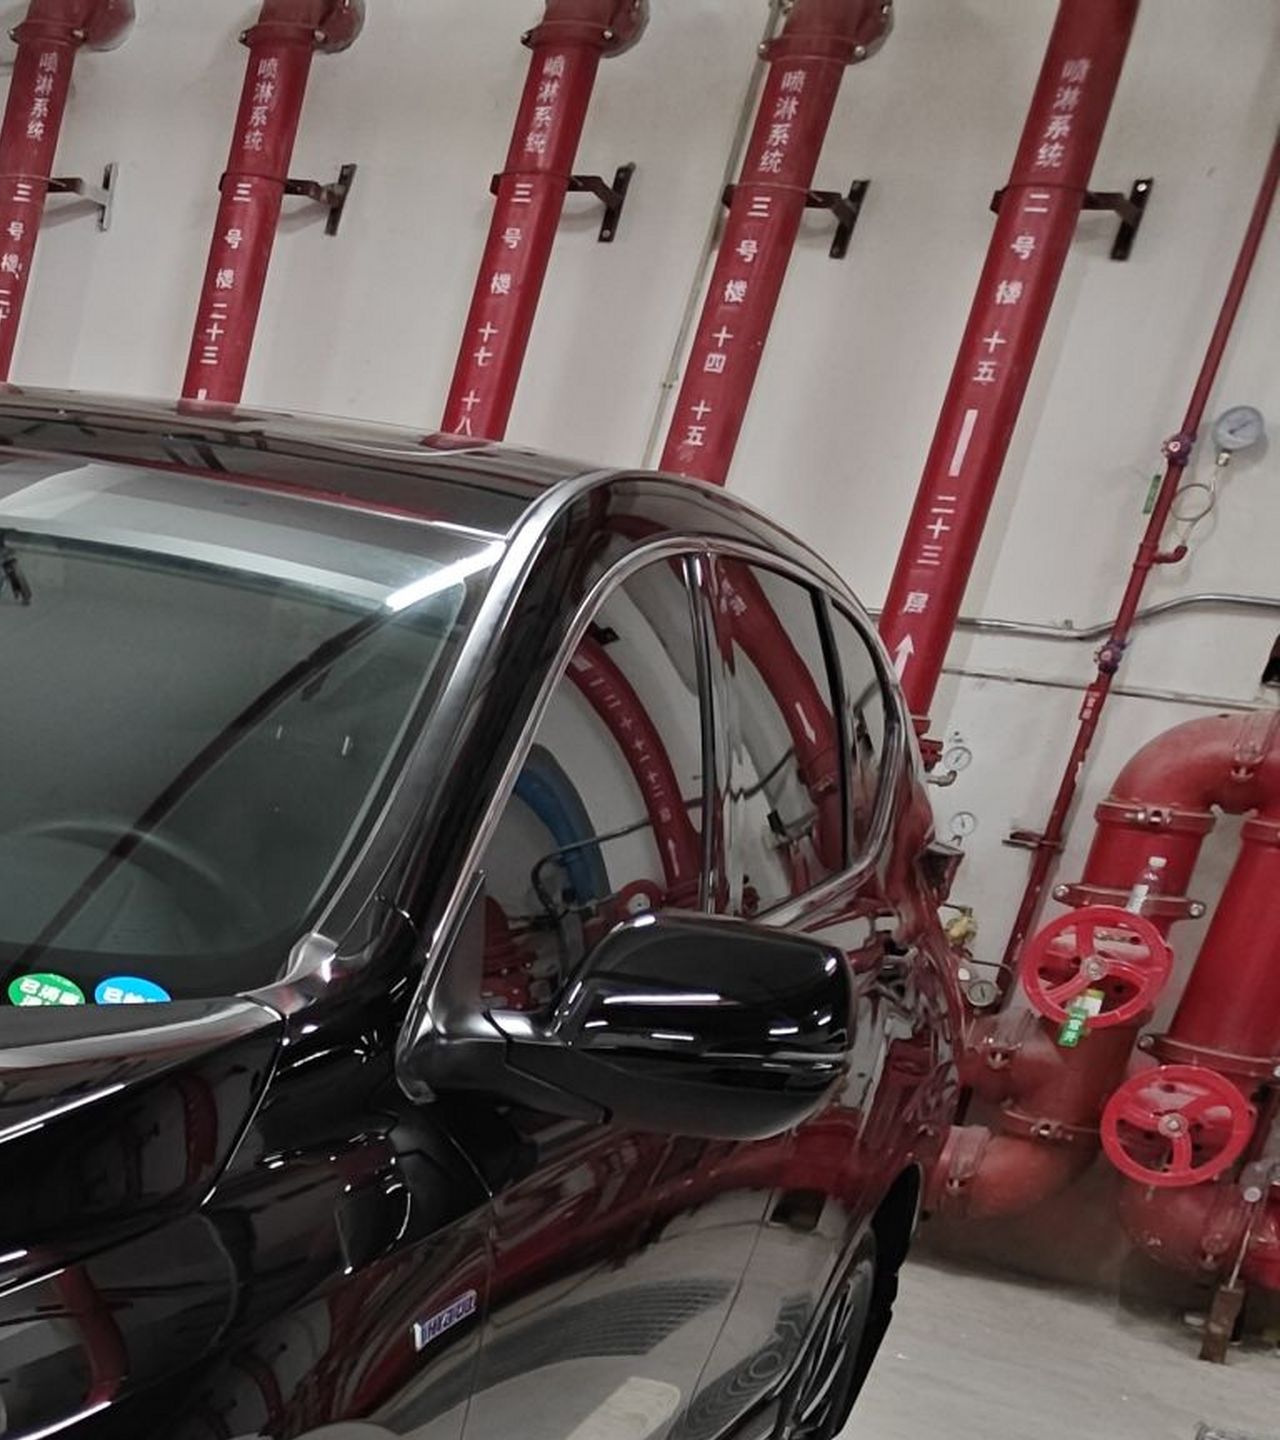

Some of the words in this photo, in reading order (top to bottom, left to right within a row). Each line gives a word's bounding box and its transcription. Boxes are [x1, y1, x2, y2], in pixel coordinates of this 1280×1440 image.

[26, 52, 59, 142] 喷淋系统
[242, 57, 279, 152] 喷淋系统
[523, 54, 566, 154] 喷淋系统
[757, 69, 807, 174] 喷淋系统
[1035, 57, 1092, 169] 喷淋系统
